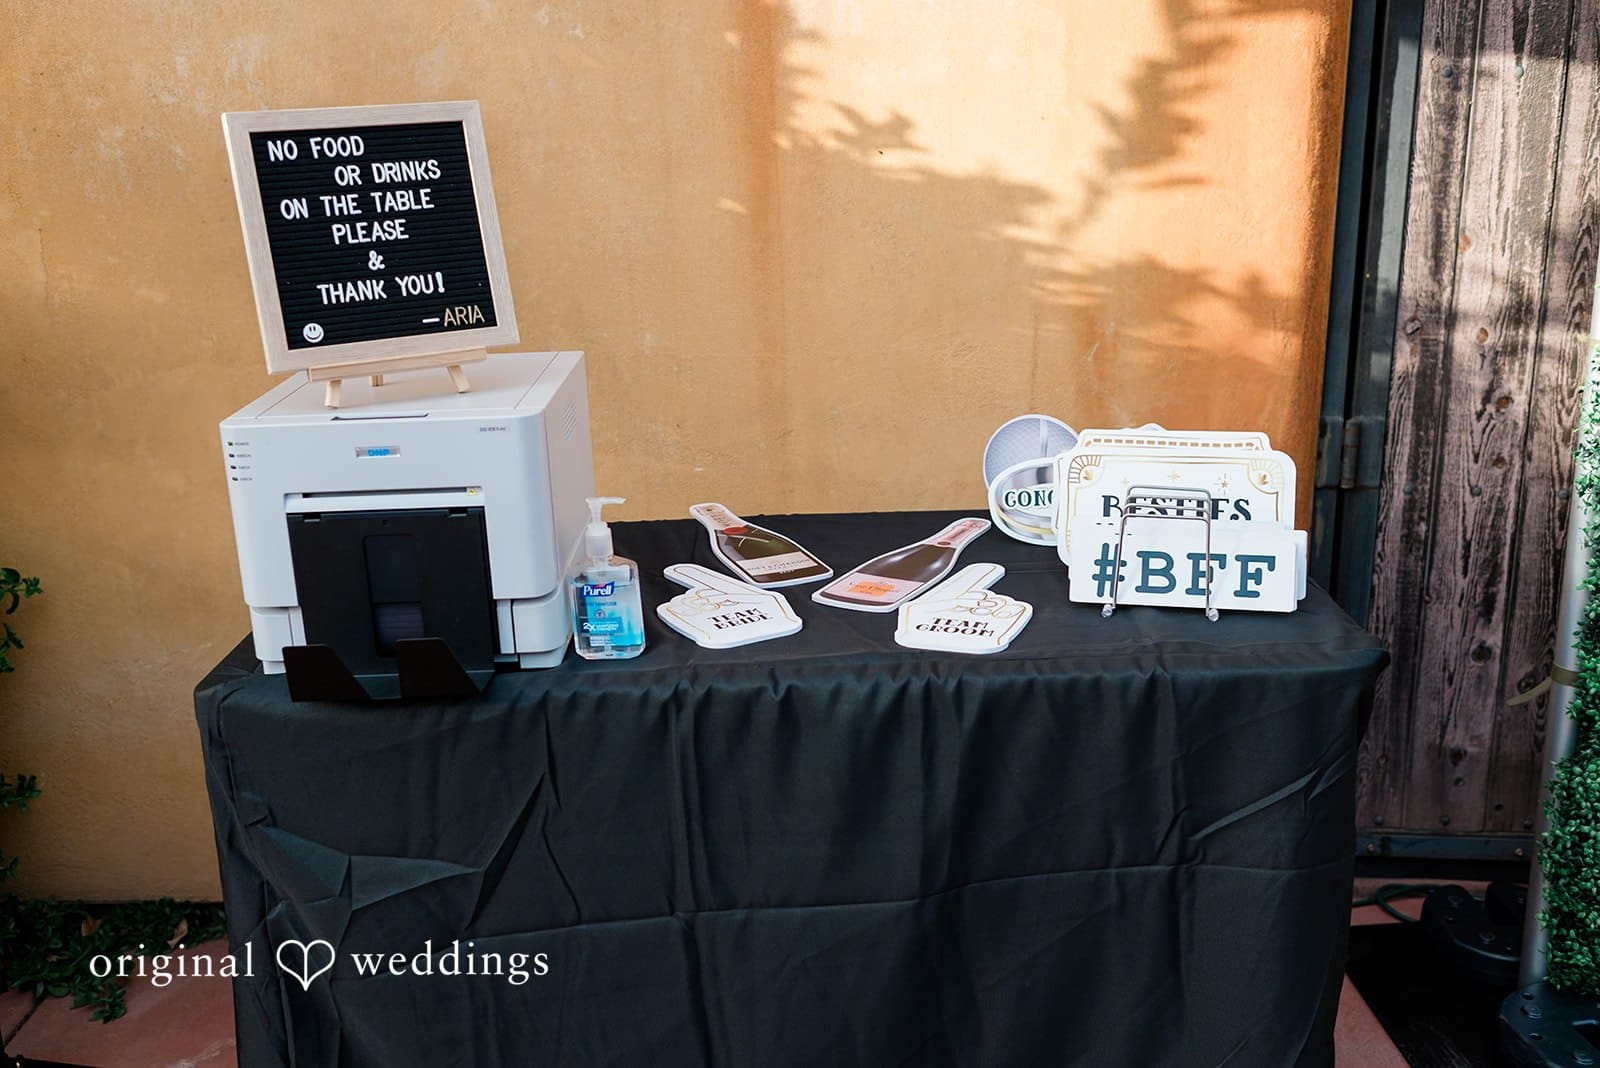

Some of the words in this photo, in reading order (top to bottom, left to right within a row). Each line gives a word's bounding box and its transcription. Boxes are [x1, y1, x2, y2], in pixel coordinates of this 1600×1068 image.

[267, 139, 298, 162] NO
[309, 135, 365, 159] FOOD
[334, 165, 362, 186] OR
[371, 159, 441, 184] DRINKS
[280, 198, 309, 220] ON
[320, 194, 362, 217] THE
[370, 188, 435, 213] TABLE
[331, 219, 409, 245] PLEASE
[368, 250, 385, 270] &
[316, 279, 387, 305] THANK
[395, 271, 445, 297] YOU!
[1091, 542, 1276, 598] #BFF
[708, 607, 761, 622] TEAM
[713, 613, 774, 630] BRIDE
[932, 617, 988, 629] TEAM
[915, 623, 995, 637] GROOM
